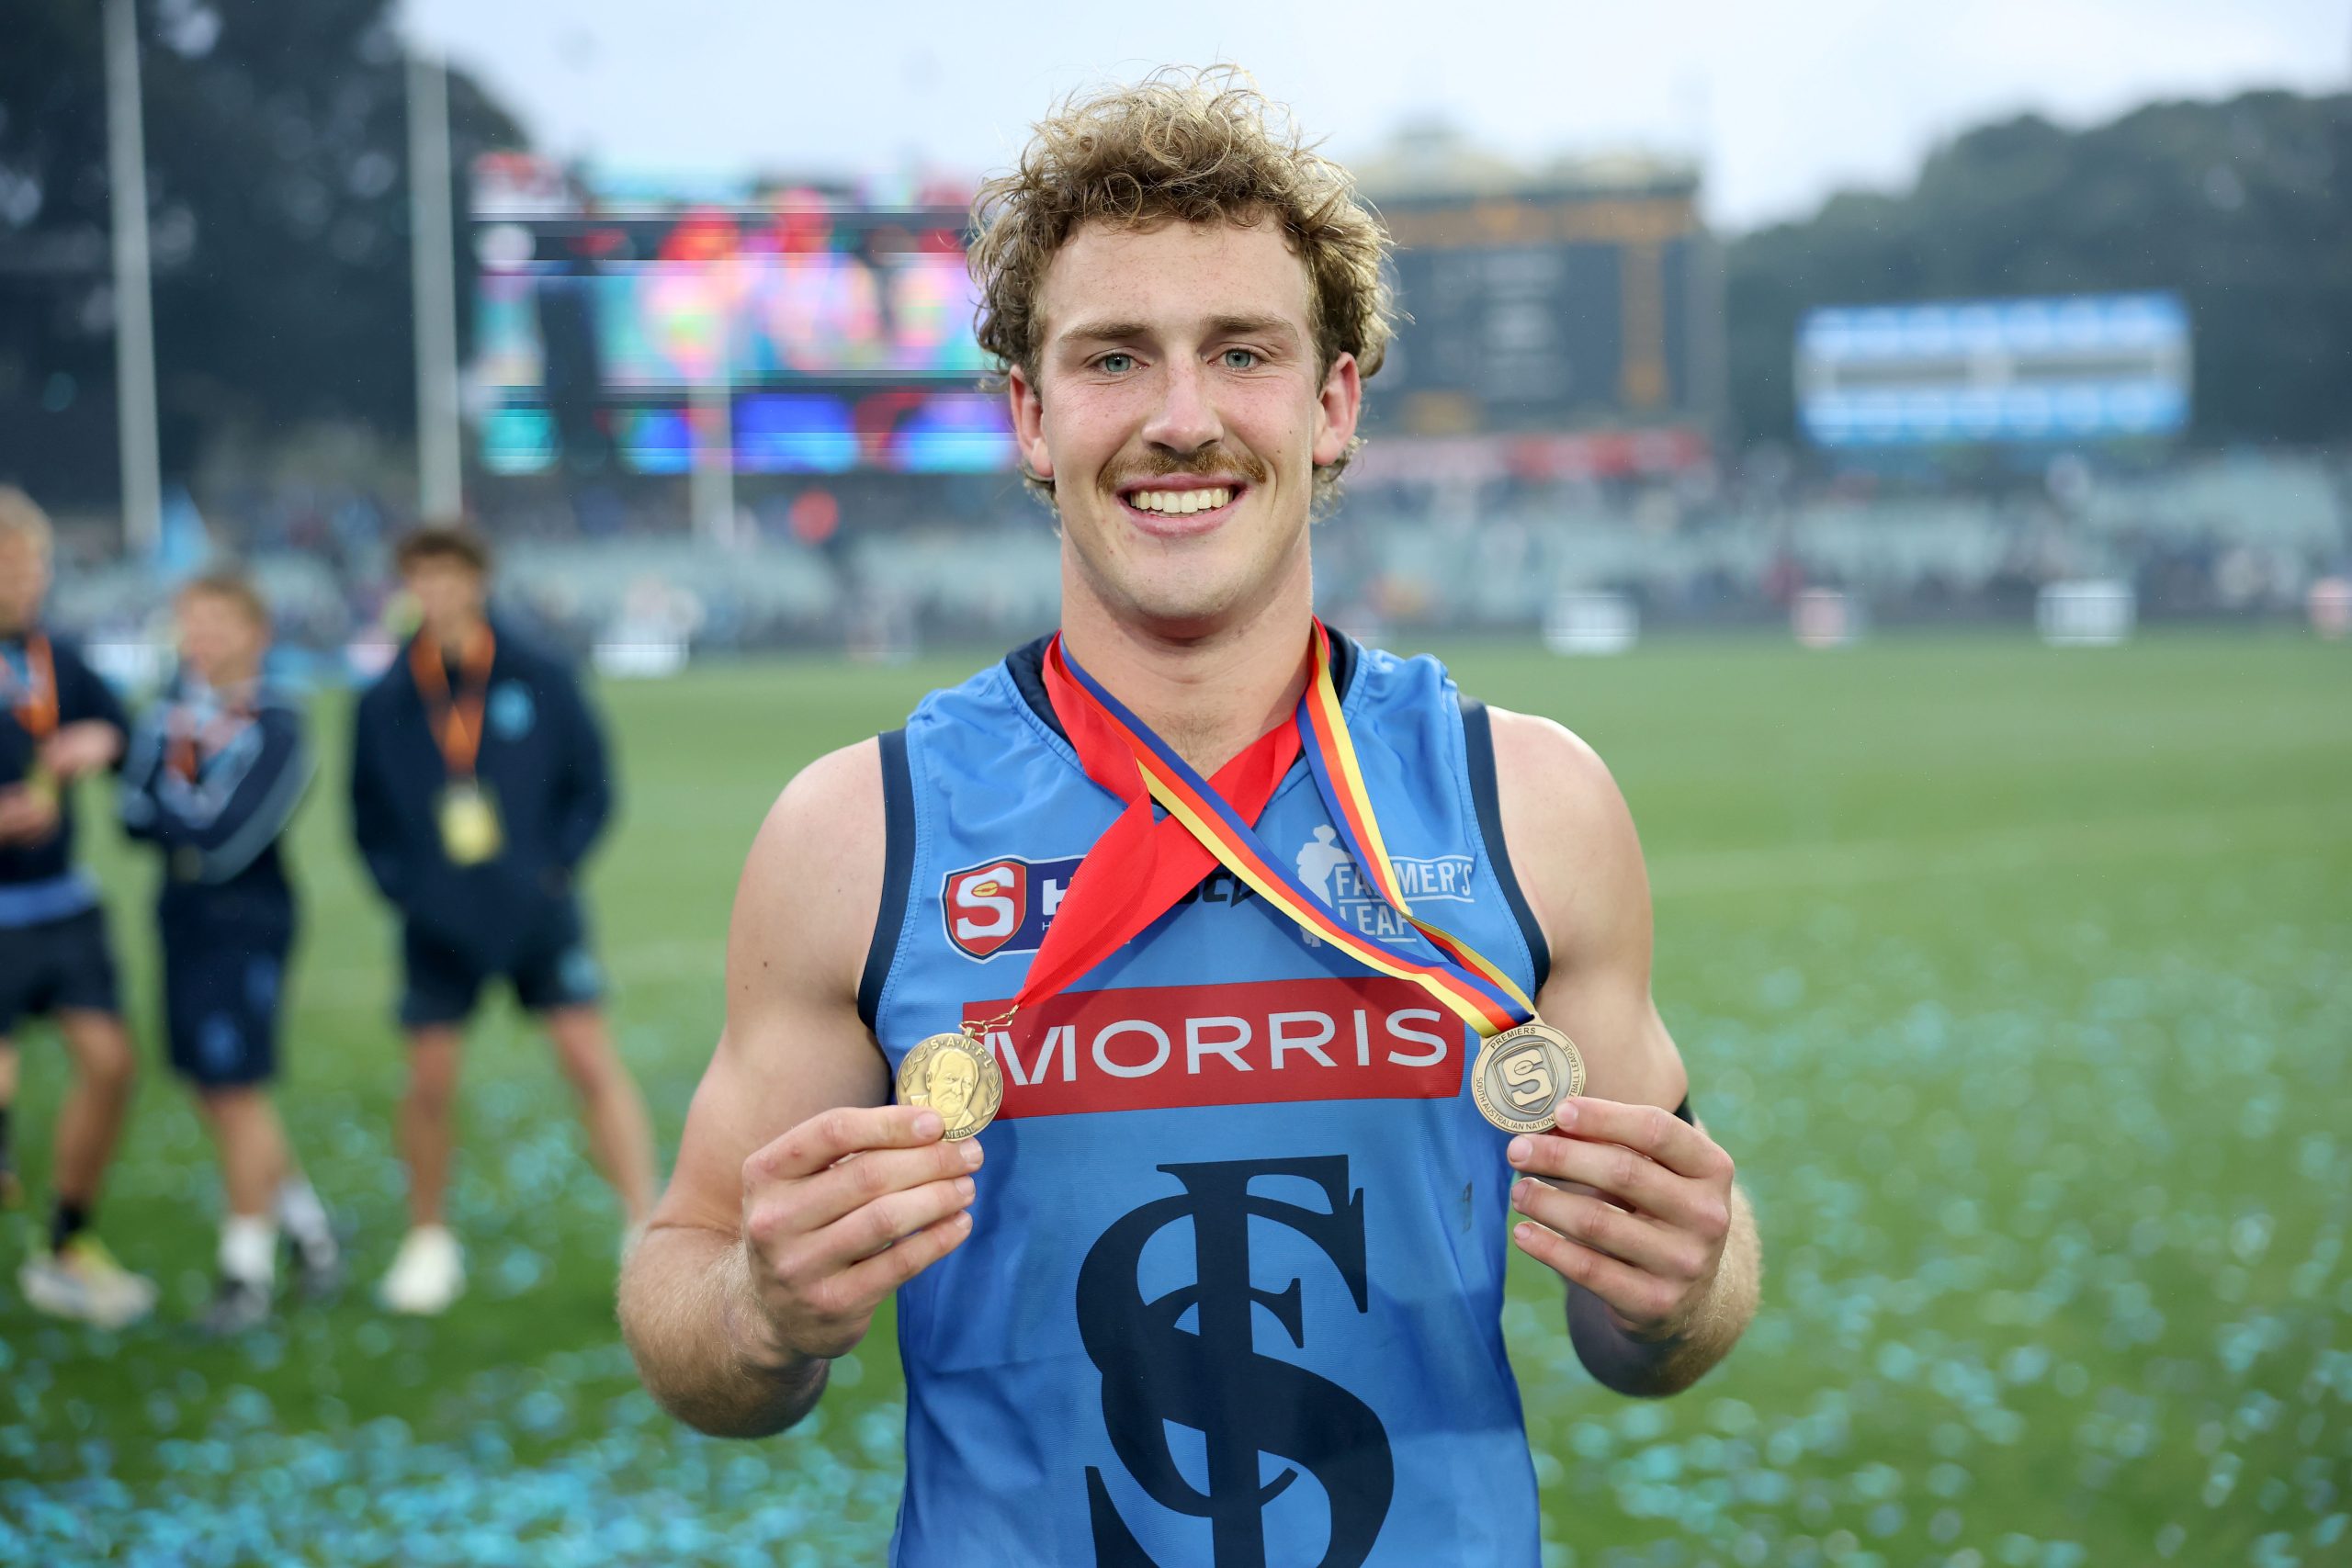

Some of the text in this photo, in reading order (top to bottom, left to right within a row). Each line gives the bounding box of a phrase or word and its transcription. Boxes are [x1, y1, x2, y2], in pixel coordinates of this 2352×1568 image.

[1335, 862, 1473, 897] FAMER'S
[983, 1009, 1447, 1086] MORRIS
[1490, 1027, 1536, 1050] PREMIERS
[1476, 1043, 1580, 1130] SOUTH AUSTRALIAN NATION TBALL LEAGUE
[945, 1126, 977, 1139] MEDAL
